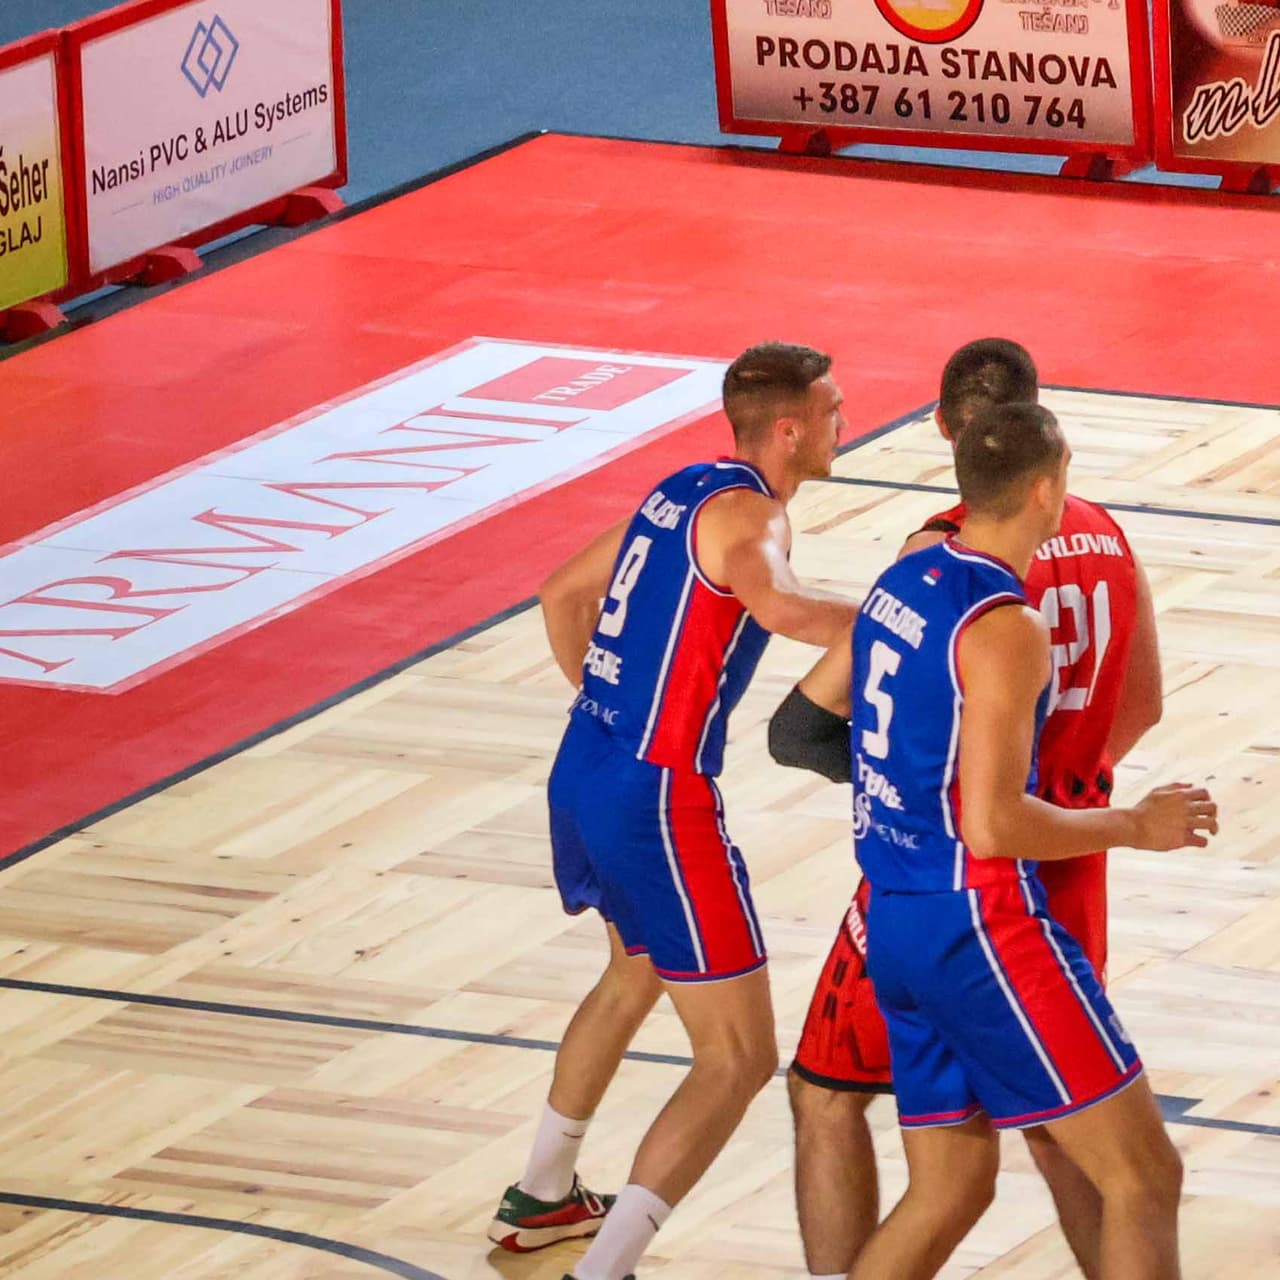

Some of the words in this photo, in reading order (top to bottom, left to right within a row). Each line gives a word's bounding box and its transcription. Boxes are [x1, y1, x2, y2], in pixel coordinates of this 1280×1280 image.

[1018, 6, 1090, 35] TEŠANJ
[756, 35, 929, 77] PRODAJA
[940, 46, 1118, 89] STANOVA
[792, 82, 879, 116] +387
[894, 87, 932, 119] 61
[947, 92, 1010, 125] 210
[1023, 95, 1087, 129] 764
[92, 150, 145, 196] Nansi
[150, 133, 190, 173] PVC
[194, 127, 209, 152] &
[212, 109, 249, 147] ALU
[254, 82, 329, 133] Systems
[182, 161, 228, 193] QUALITY
[229, 144, 274, 176] JOINERY
[531, 362, 633, 404] TRADE
[598, 535, 653, 638] 9
[1040, 580, 1112, 718] 21
[862, 639, 902, 760] 5
